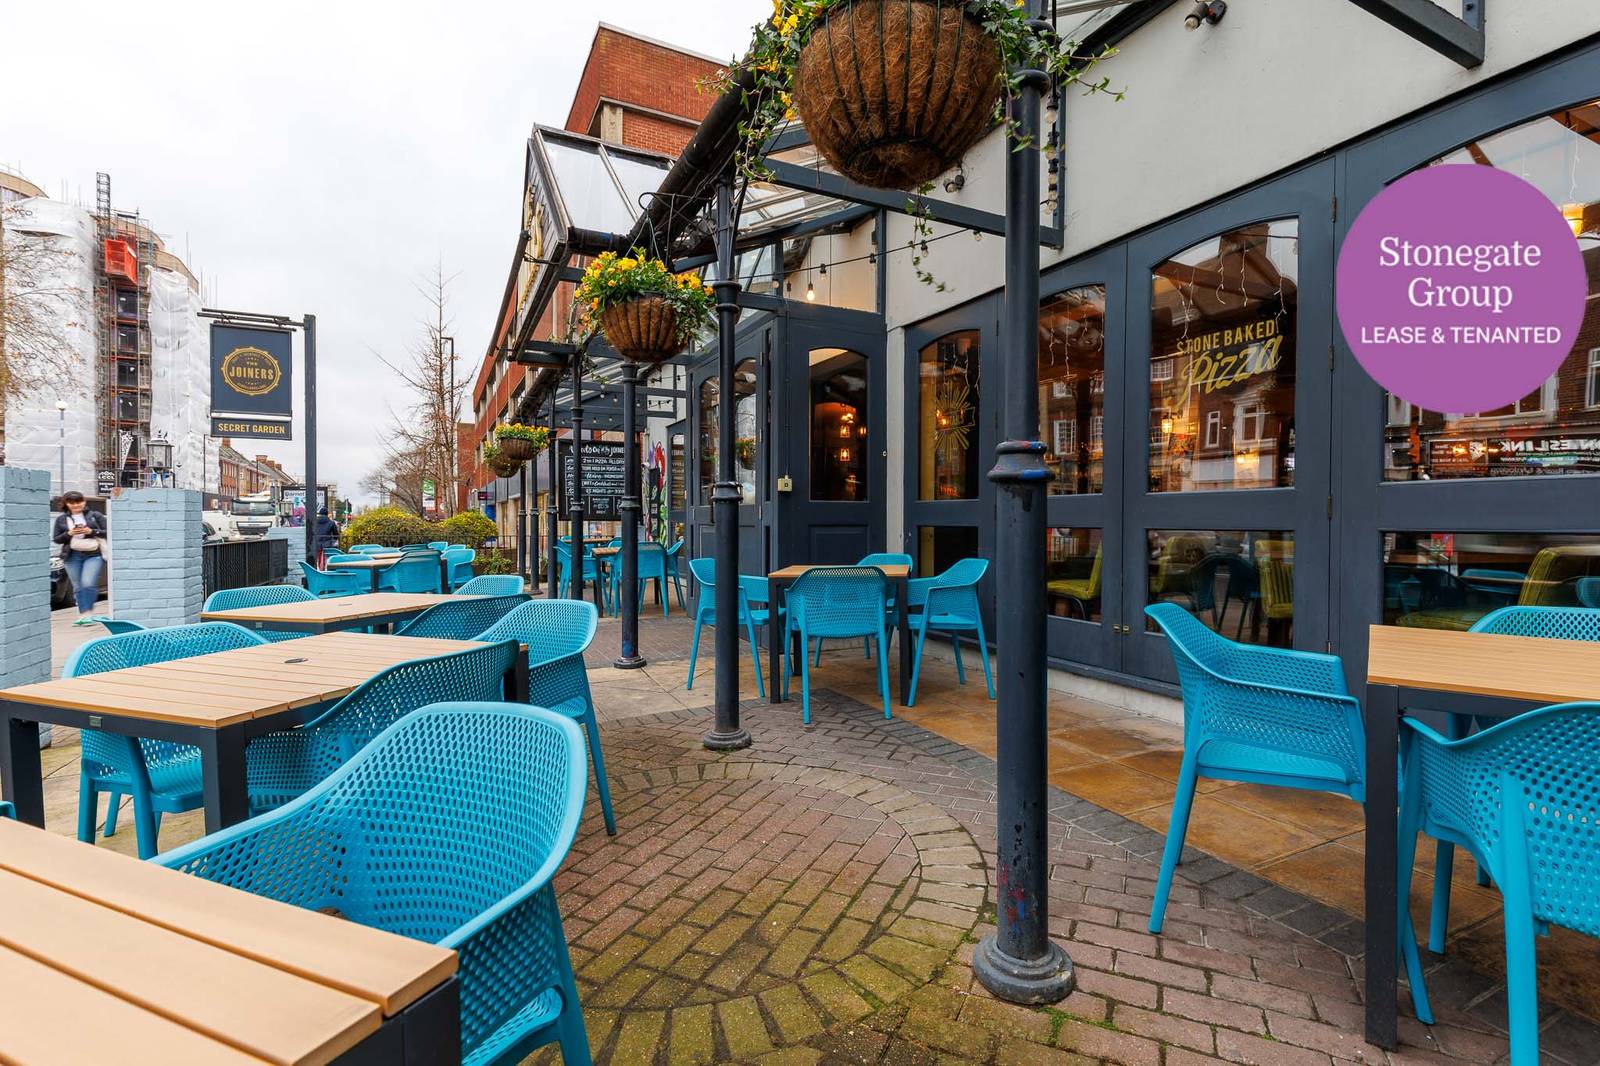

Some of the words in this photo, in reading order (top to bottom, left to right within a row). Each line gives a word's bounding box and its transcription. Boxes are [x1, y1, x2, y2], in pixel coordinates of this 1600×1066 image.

[1176, 332, 1221, 354] STONE
[1224, 319, 1276, 346] BAKED
[229, 366, 274, 380] JOINERS
[1175, 335, 1284, 408] Pizza
[218, 423, 250, 433] SECRET
[252, 424, 285, 434] GARDEN
